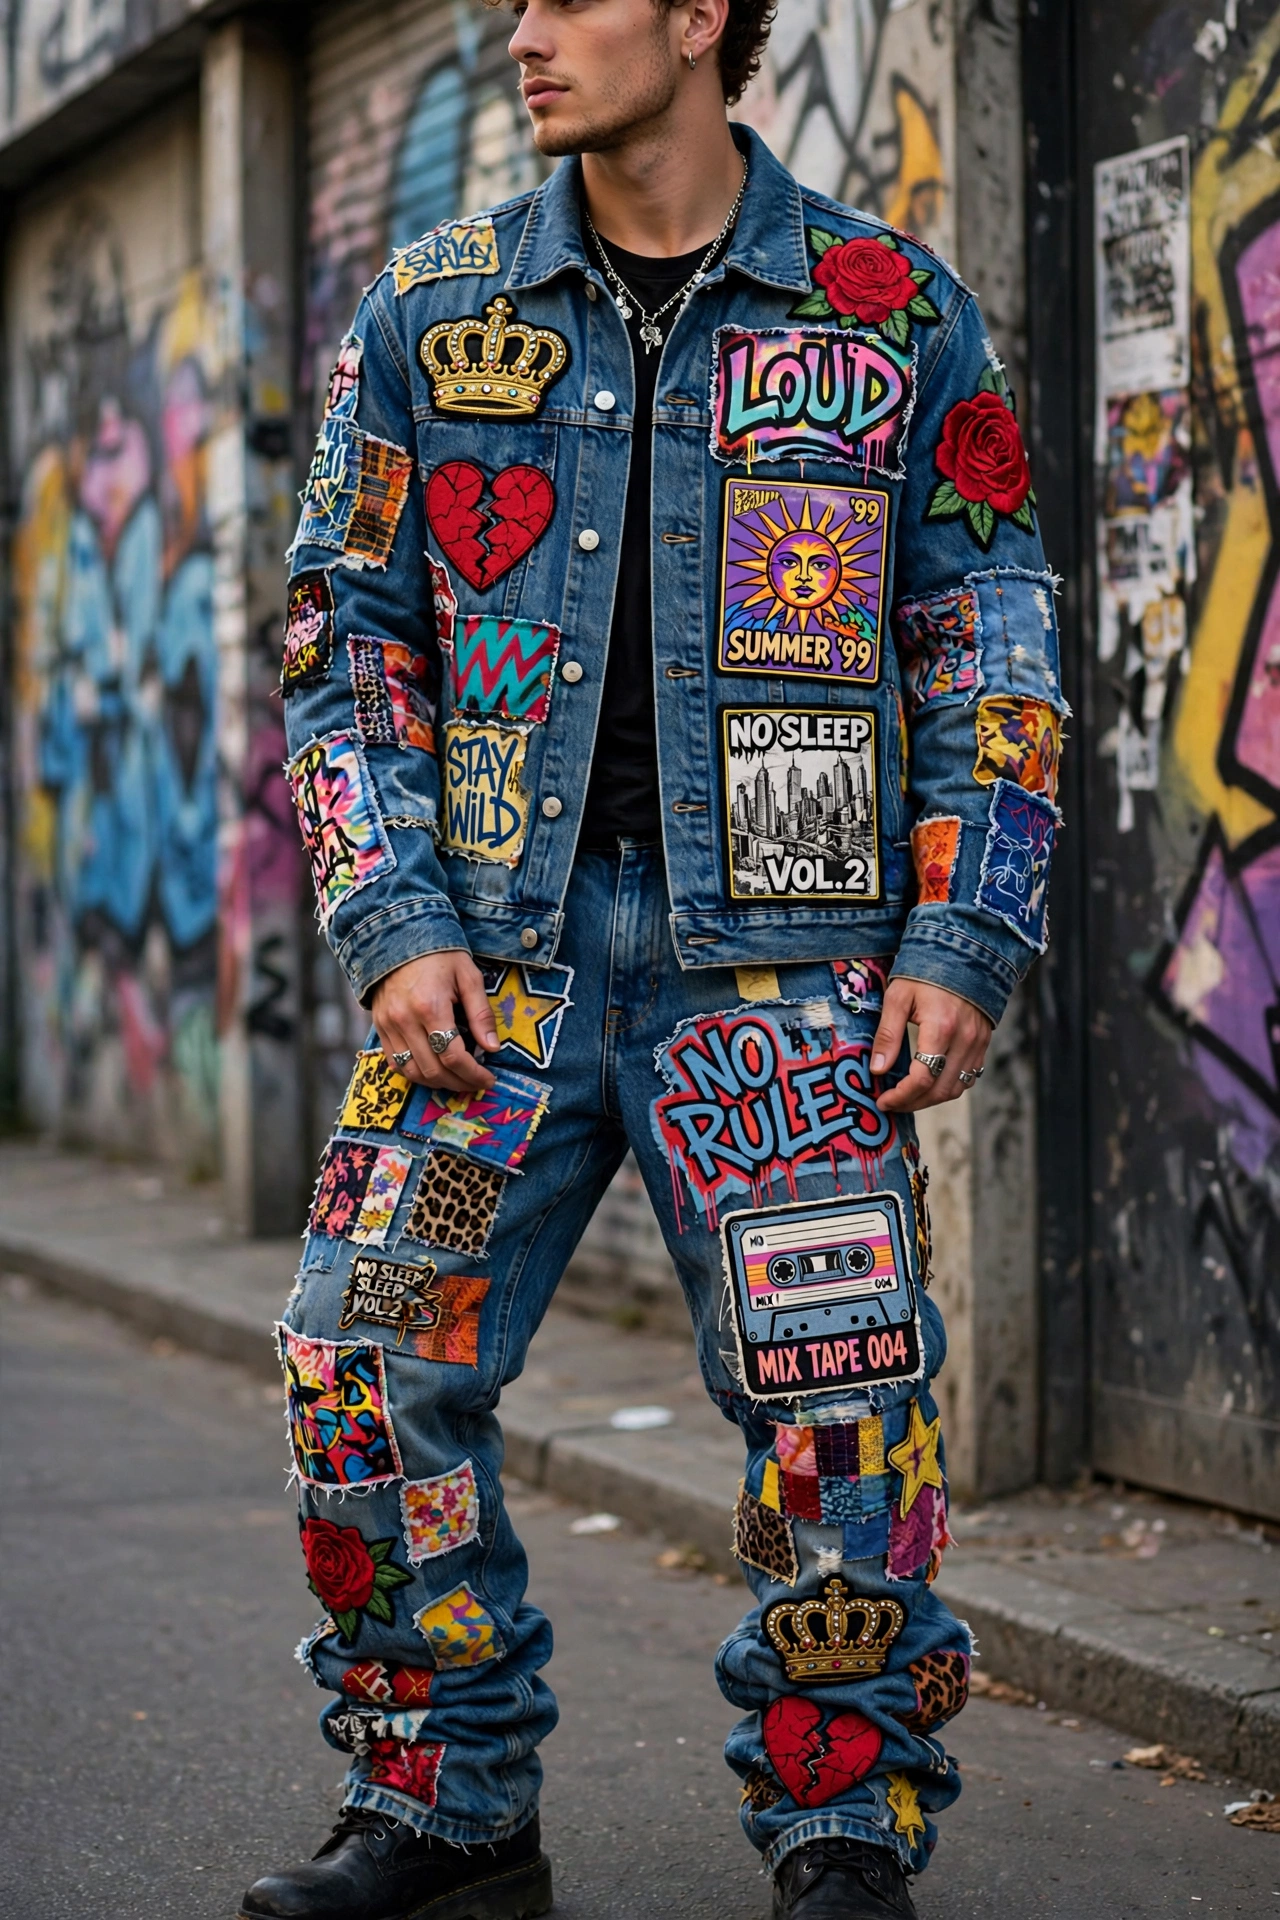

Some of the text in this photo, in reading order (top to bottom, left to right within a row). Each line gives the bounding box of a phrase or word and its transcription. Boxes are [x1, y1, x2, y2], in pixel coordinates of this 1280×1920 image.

[722, 341, 904, 437] LOUD
[849, 496, 881, 525] '99
[726, 628, 873, 672] SUMMER '99
[729, 714, 871, 750] NO SLEEP
[447, 735, 519, 798] STAY
[676, 1022, 776, 1102] NO
[664, 1052, 891, 1181] RULES
[355, 1260, 378, 1278] NO
[356, 1277, 405, 1297] SLEEP
[756, 1330, 908, 1386] MIX TAPE 004
